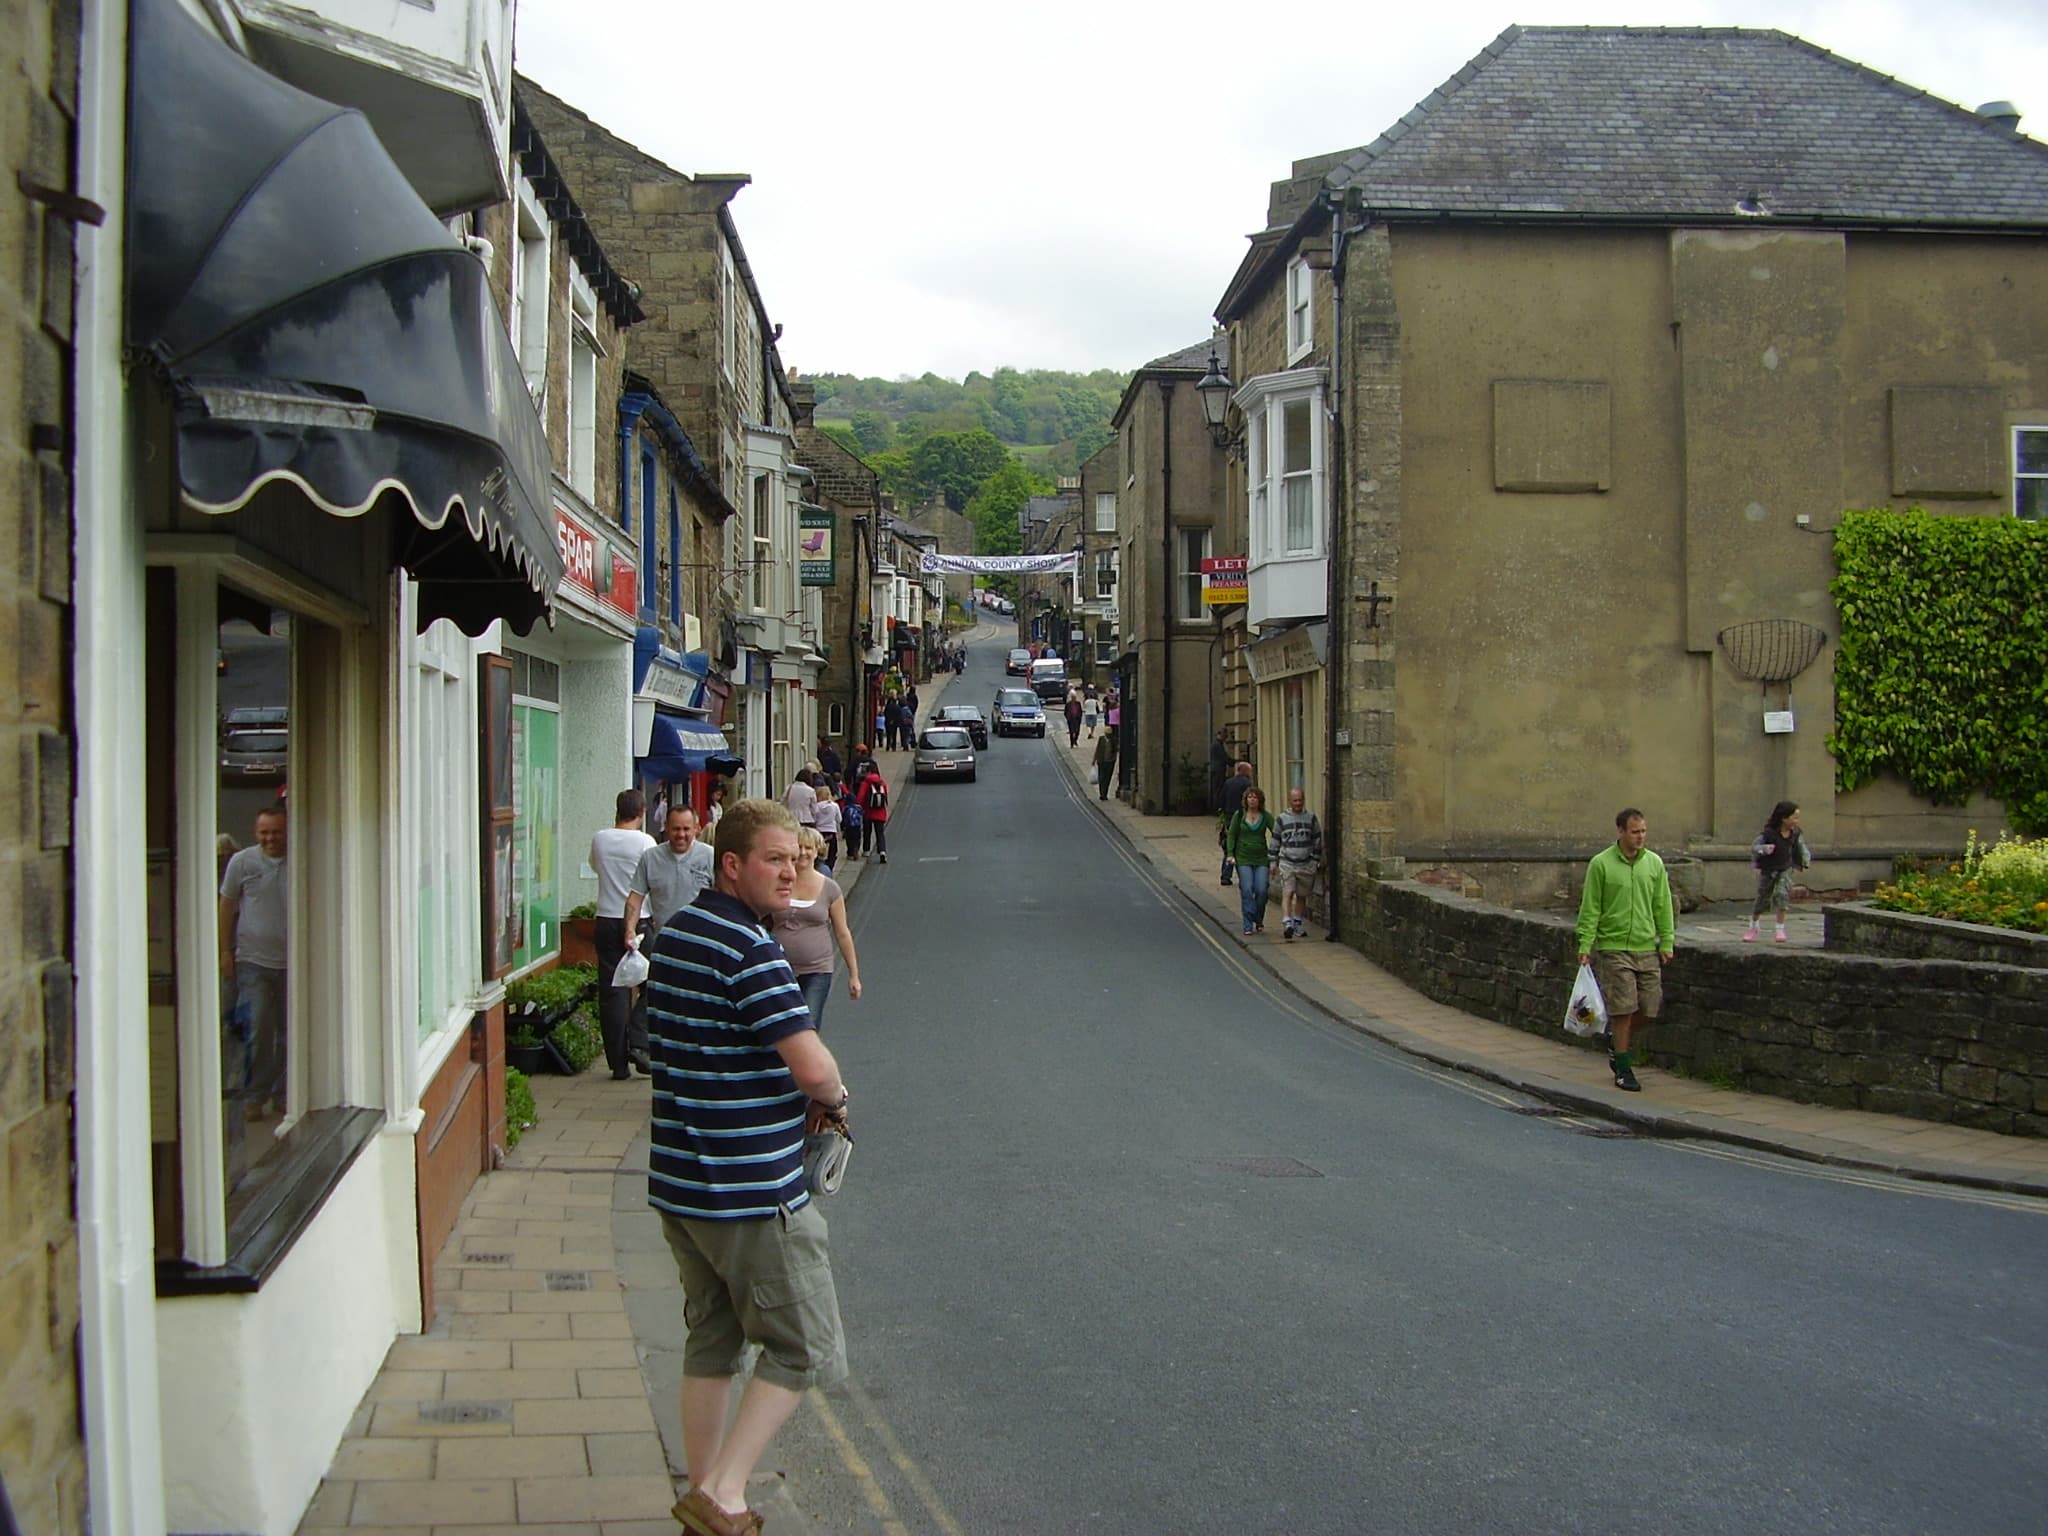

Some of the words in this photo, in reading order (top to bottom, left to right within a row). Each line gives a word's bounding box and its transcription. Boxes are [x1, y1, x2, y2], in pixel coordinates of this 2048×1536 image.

[558, 520, 593, 582] SPAR
[940, 559, 981, 570] ANNUAL
[984, 560, 1024, 570] COUNTY
[1027, 559, 1056, 569] SHOW
[1214, 559, 1245, 569] LET
